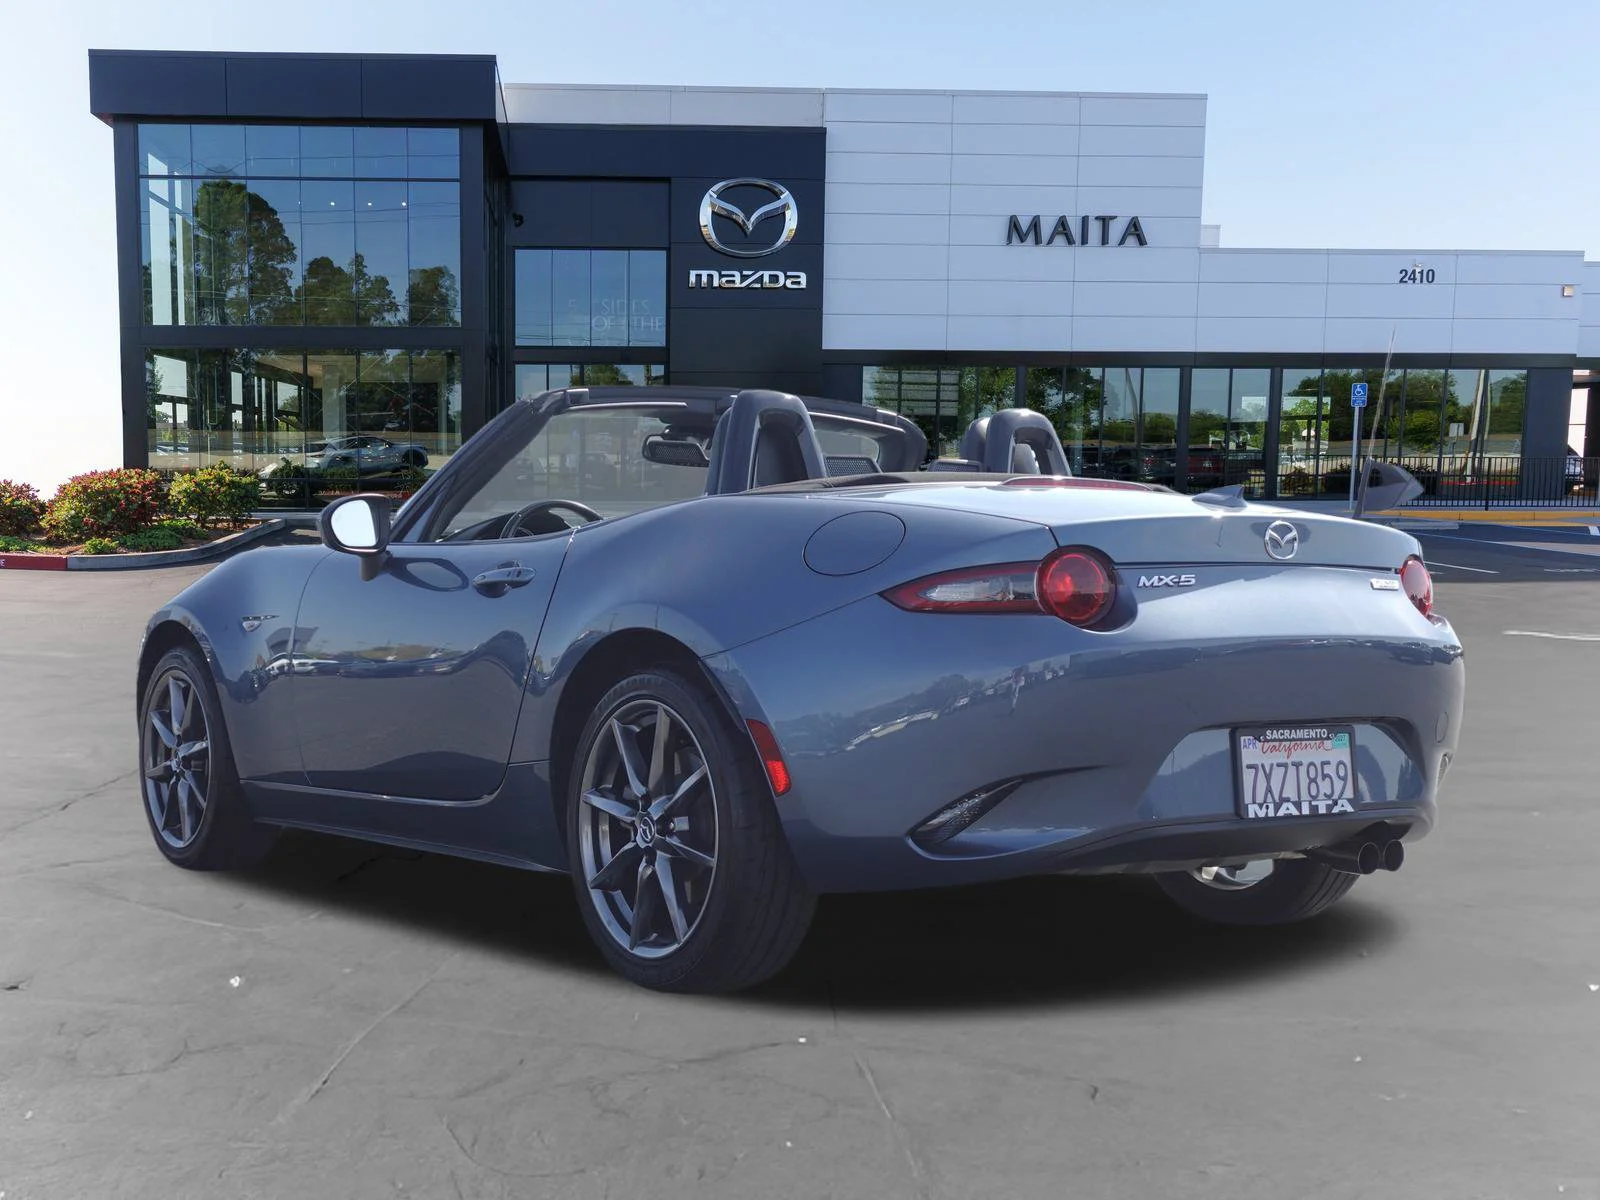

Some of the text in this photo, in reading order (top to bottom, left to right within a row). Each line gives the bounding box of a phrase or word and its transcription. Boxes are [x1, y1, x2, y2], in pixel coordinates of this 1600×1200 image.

[1006, 214, 1148, 246] MAITA
[688, 269, 807, 289] mazda
[1398, 268, 1436, 285] 2410
[1137, 574, 1196, 588] MX-5
[1265, 728, 1328, 740] SACRAMENTO
[1242, 738, 1258, 750] APR
[1261, 740, 1333, 759] California
[1246, 760, 1348, 803] 7XZT859
[1247, 799, 1355, 818] MAITA
